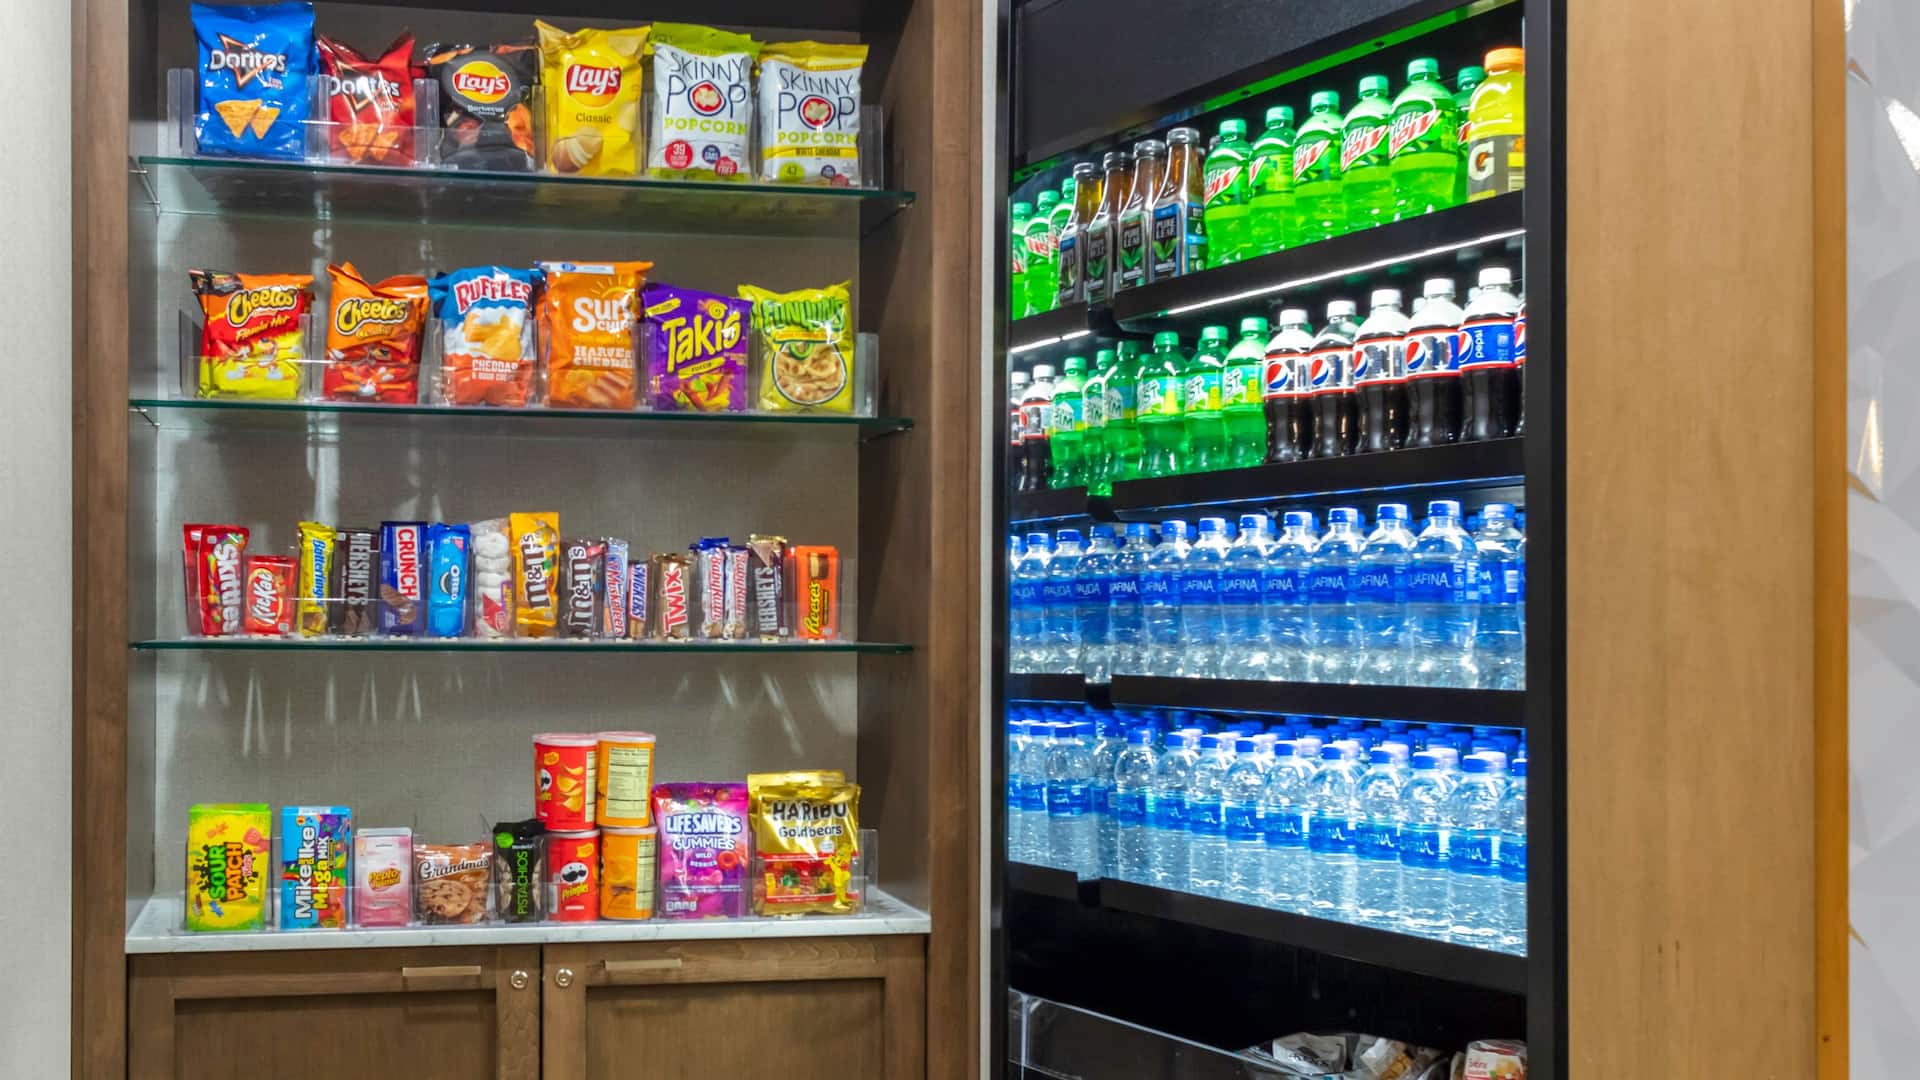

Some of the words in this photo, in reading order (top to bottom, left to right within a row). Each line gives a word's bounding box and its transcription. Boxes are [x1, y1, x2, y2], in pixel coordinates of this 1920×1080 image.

[210, 49, 287, 73] Doritos
[329, 74, 400, 98] Doritos
[458, 73, 506, 95] Lay's
[569, 65, 620, 95] Lay's
[575, 111, 612, 124] Classic
[664, 117, 748, 136] POPCORN
[777, 131, 857, 145] POPCORN
[1468, 140, 1495, 181] G
[228, 286, 297, 325] Cheetos
[455, 278, 532, 315] RUFFLES
[337, 299, 407, 333] Cheetos
[661, 303, 741, 373] Takis
[1474, 329, 1485, 359] pepsi
[398, 528, 418, 598] CRUNCH
[214, 543, 241, 632] Skittles
[450, 565, 460, 600] OREO
[631, 564, 645, 619] SNICKERS
[665, 813, 692, 834] LIFE
[692, 813, 742, 834] SAVERS
[771, 801, 848, 822] HARIBO
[298, 826, 315, 858] Ike
[673, 837, 735, 850] GUMMIES
[779, 824, 842, 838] Goldbears
[209, 845, 226, 899] SOUR
[225, 841, 247, 902] PATCH
[313, 858, 333, 910] Mega
[517, 851, 528, 915] PISTACHIOS
[295, 866, 314, 919] Mike
